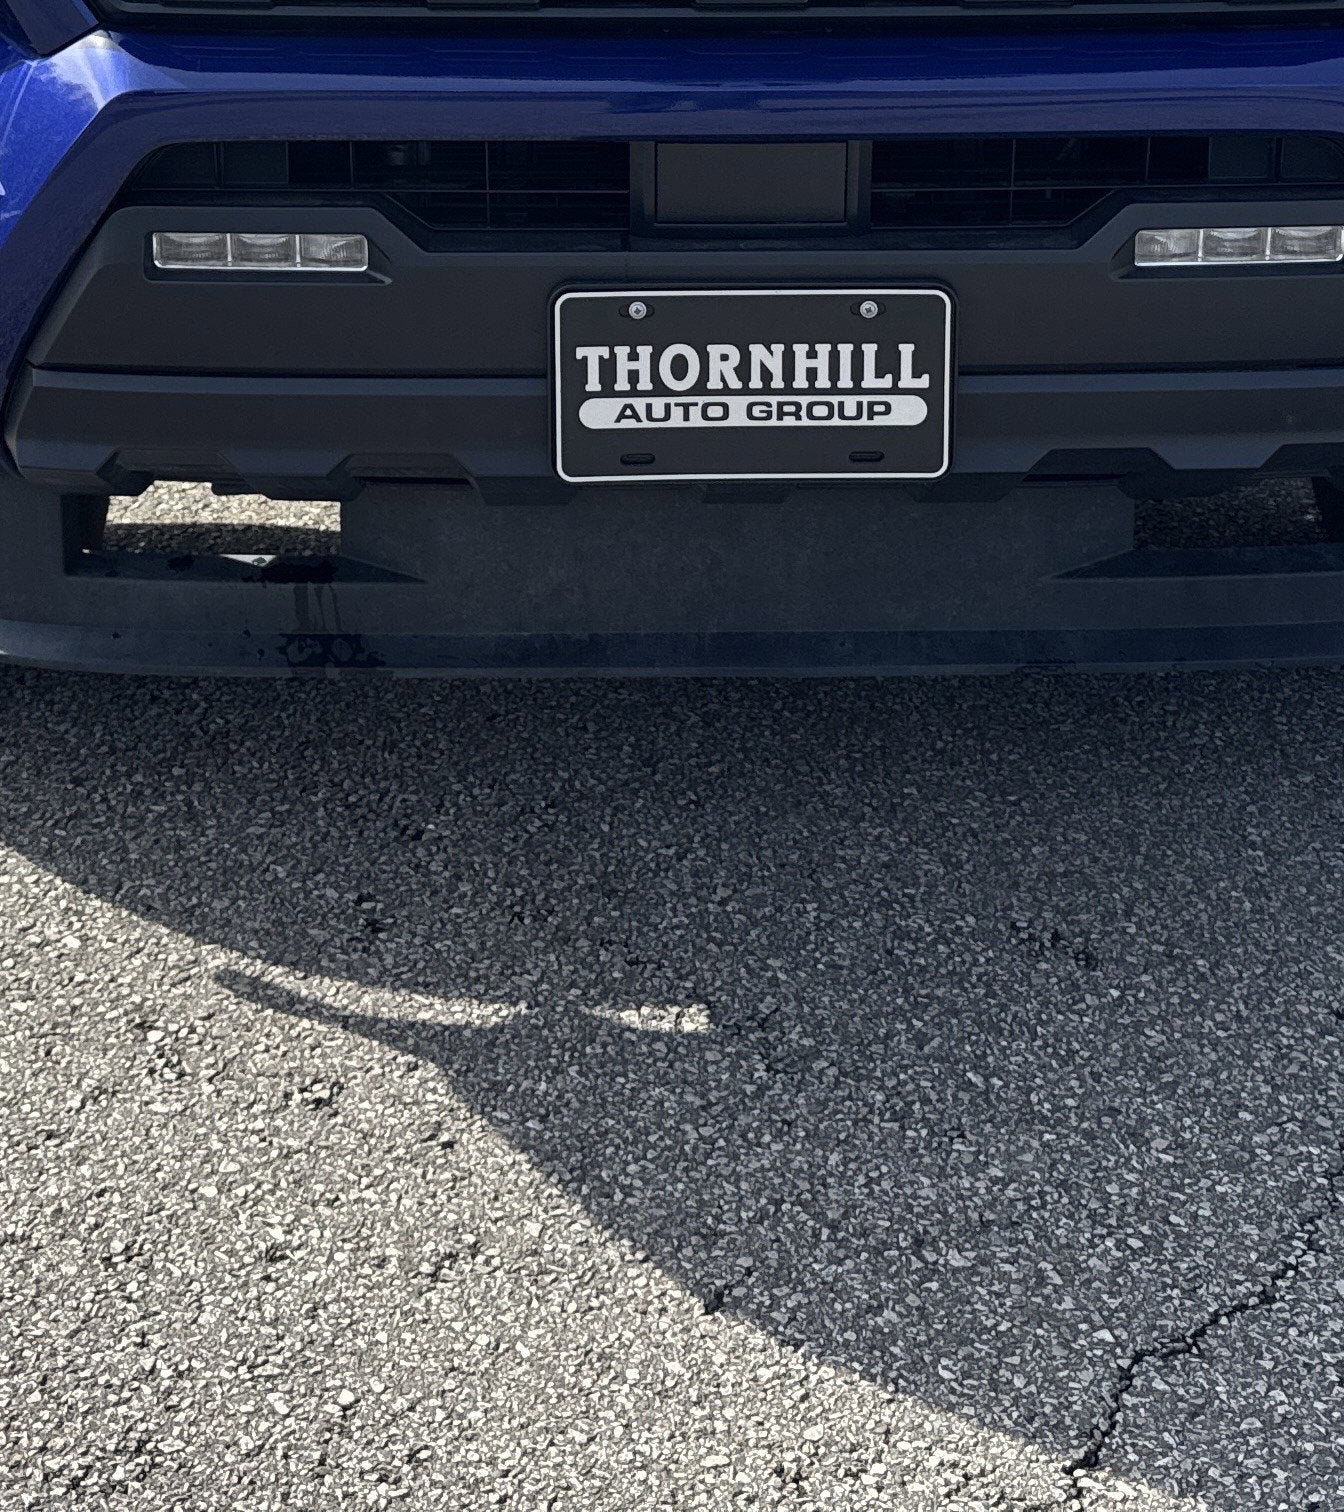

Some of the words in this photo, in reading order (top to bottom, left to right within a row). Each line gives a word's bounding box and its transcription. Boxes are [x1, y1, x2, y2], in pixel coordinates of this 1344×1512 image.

[575, 343, 930, 392] THORNHILL
[614, 401, 730, 424] AUTO
[746, 399, 893, 422] GROUP
